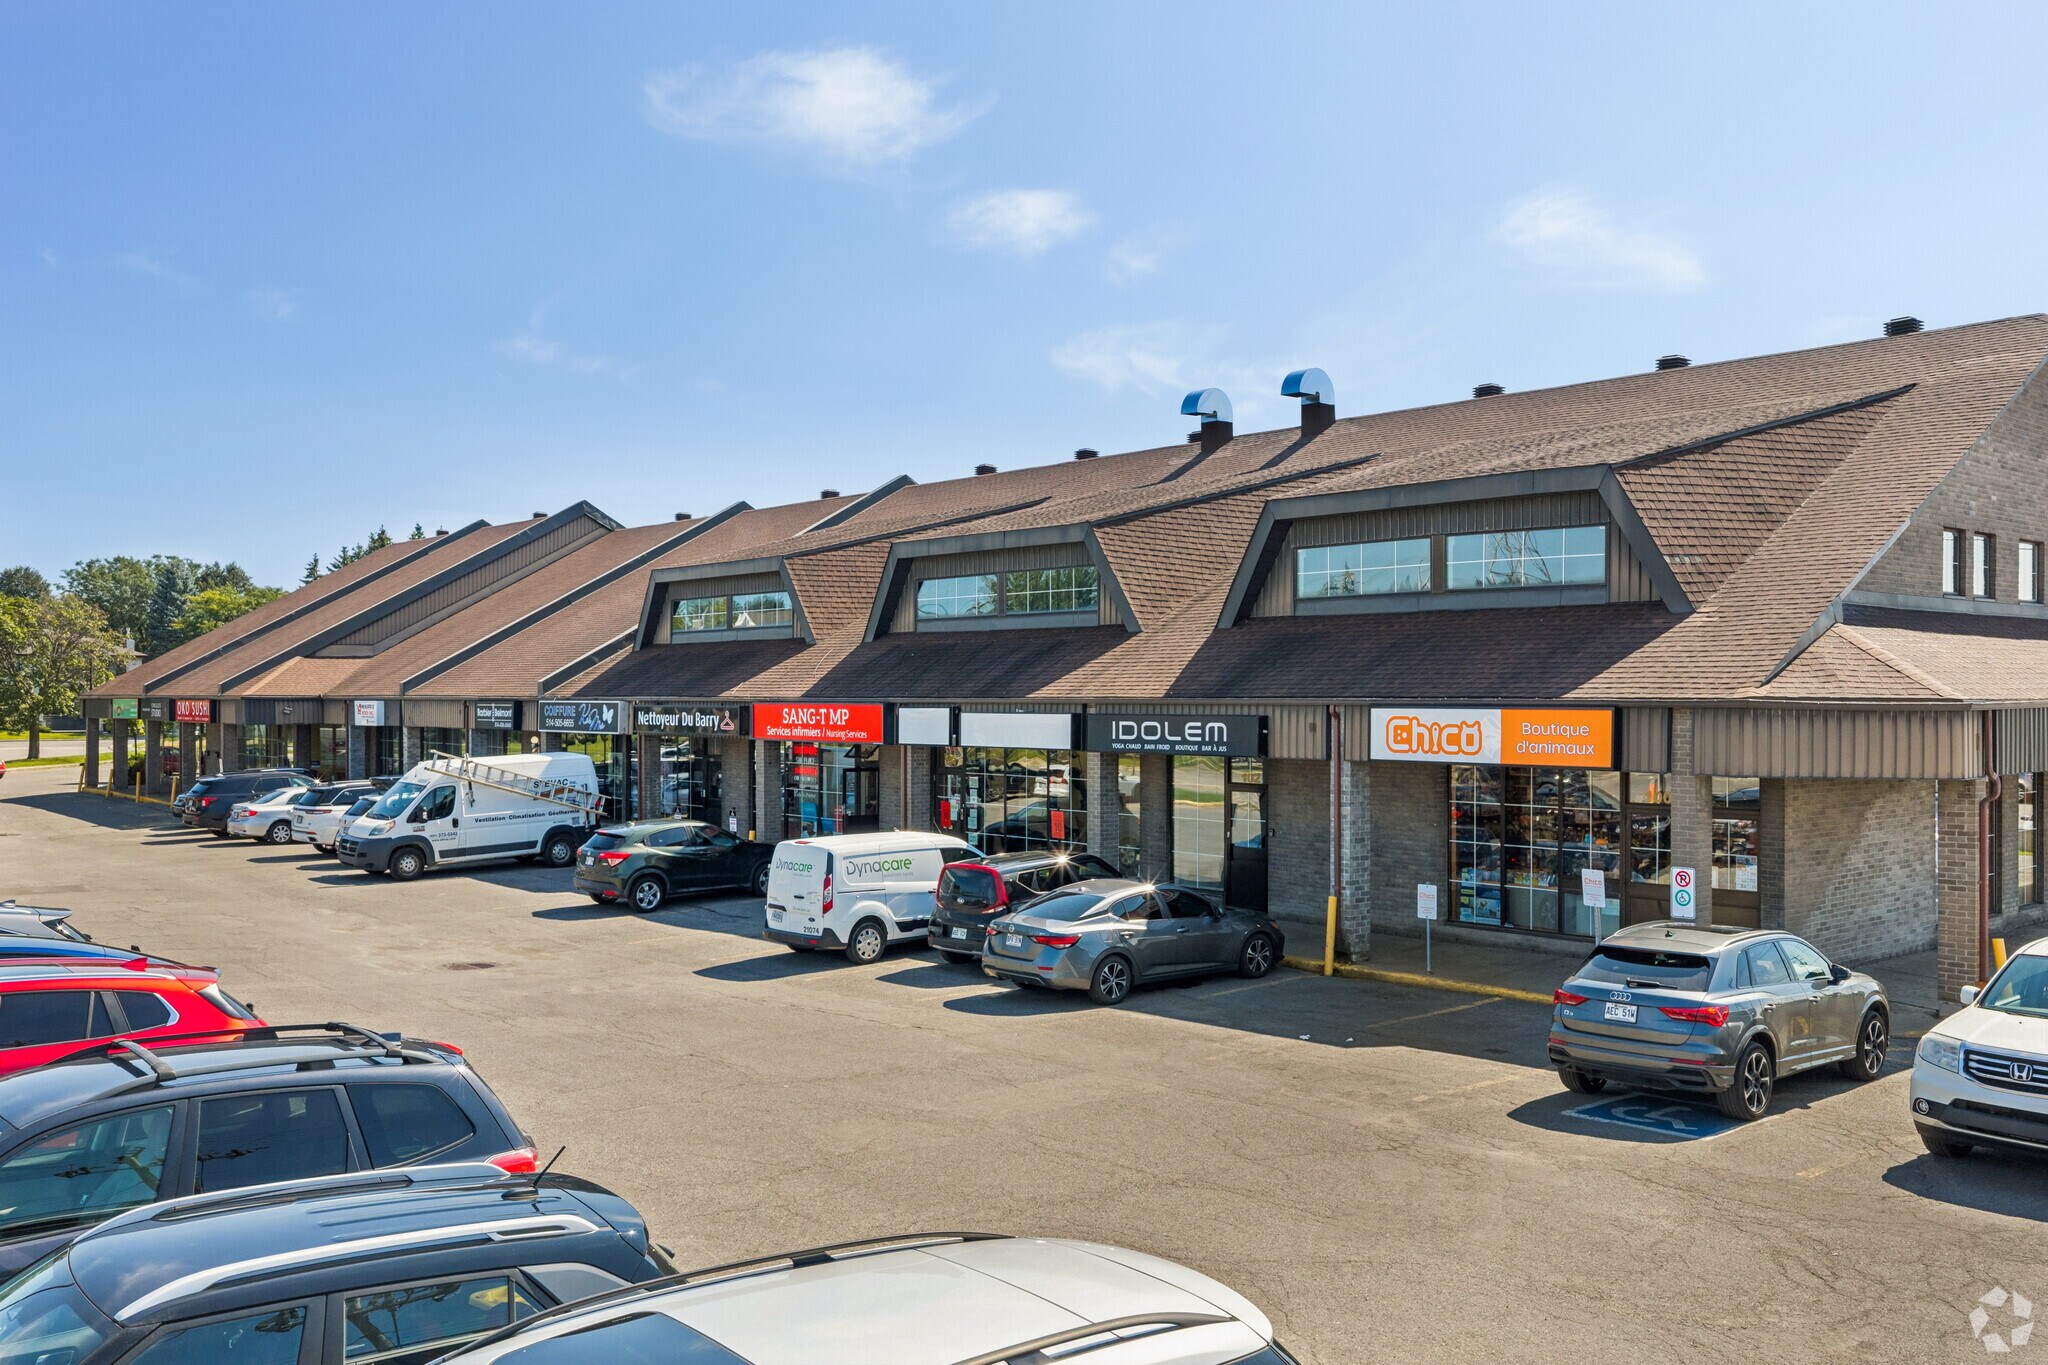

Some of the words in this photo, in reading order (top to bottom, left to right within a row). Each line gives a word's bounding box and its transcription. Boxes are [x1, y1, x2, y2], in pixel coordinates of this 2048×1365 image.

[176, 702, 190, 716] OKO
[191, 702, 210, 716] SUSHI
[477, 708, 492, 717] Barbier
[494, 708, 512, 717] Belmont
[544, 705, 576, 717] COIFFURE
[637, 711, 680, 728] Nettoyeur
[681, 711, 693, 727] Du
[695, 712, 720, 731] Barry
[782, 708, 827, 725] SANG-T
[829, 708, 849, 725] MP
[767, 726, 791, 736] Services
[792, 726, 821, 737] infirmiers
[826, 729, 845, 740] Nursing
[846, 729, 867, 739] Services
[1112, 721, 1227, 742] IDOLEM
[1386, 715, 1482, 756] Chico
[1522, 722, 1589, 738] Boutique
[1175, 744, 1198, 752] BOUTIQUE
[1516, 740, 1595, 756] d'animaux
[474, 815, 505, 823] Ventilation
[509, 812, 546, 820] Climatisation
[776, 858, 813, 872] Dynacare
[846, 858, 913, 877] Dynacare
[803, 926, 820, 934] 21074
[1606, 1006, 1619, 1016] AEC
[1622, 1008, 1635, 1018] 51W
